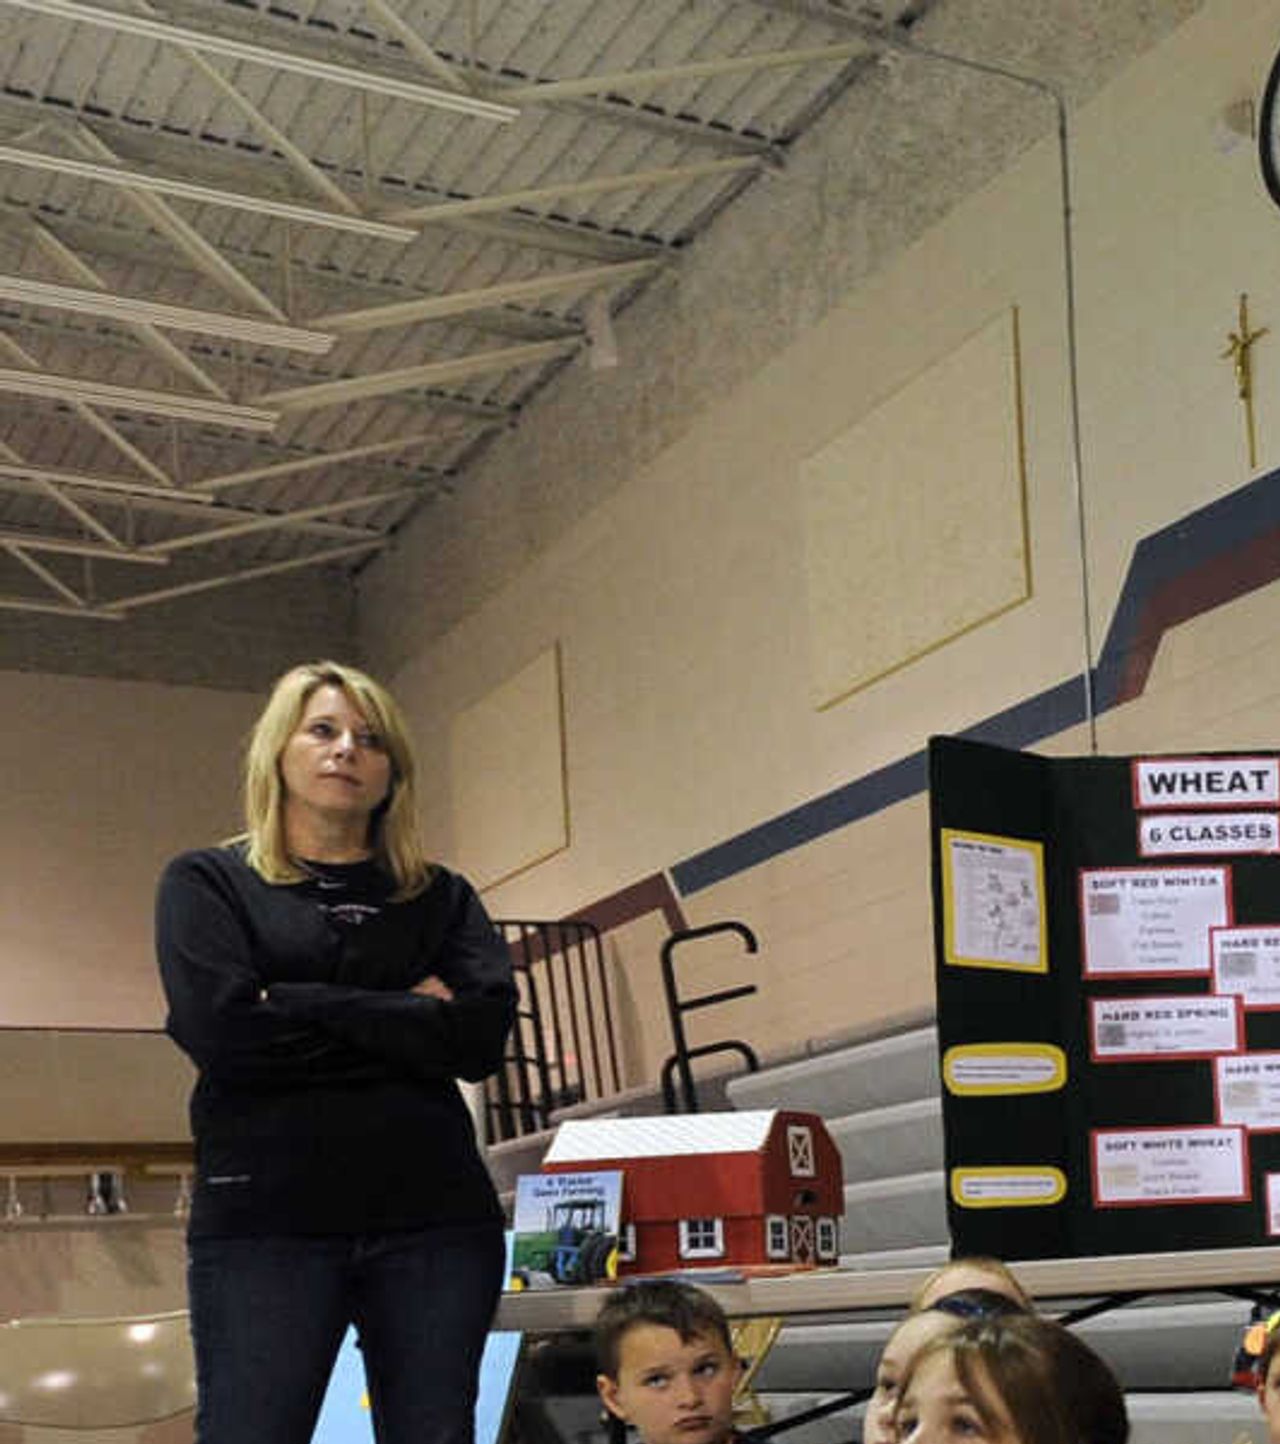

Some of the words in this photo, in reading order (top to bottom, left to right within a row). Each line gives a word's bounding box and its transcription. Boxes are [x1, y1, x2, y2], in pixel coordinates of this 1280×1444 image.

[1148, 770, 1270, 794] WHEAT
[1150, 828, 1162, 843] 6
[1169, 823, 1272, 842] CLASSES
[1164, 876, 1218, 887] WINTER
